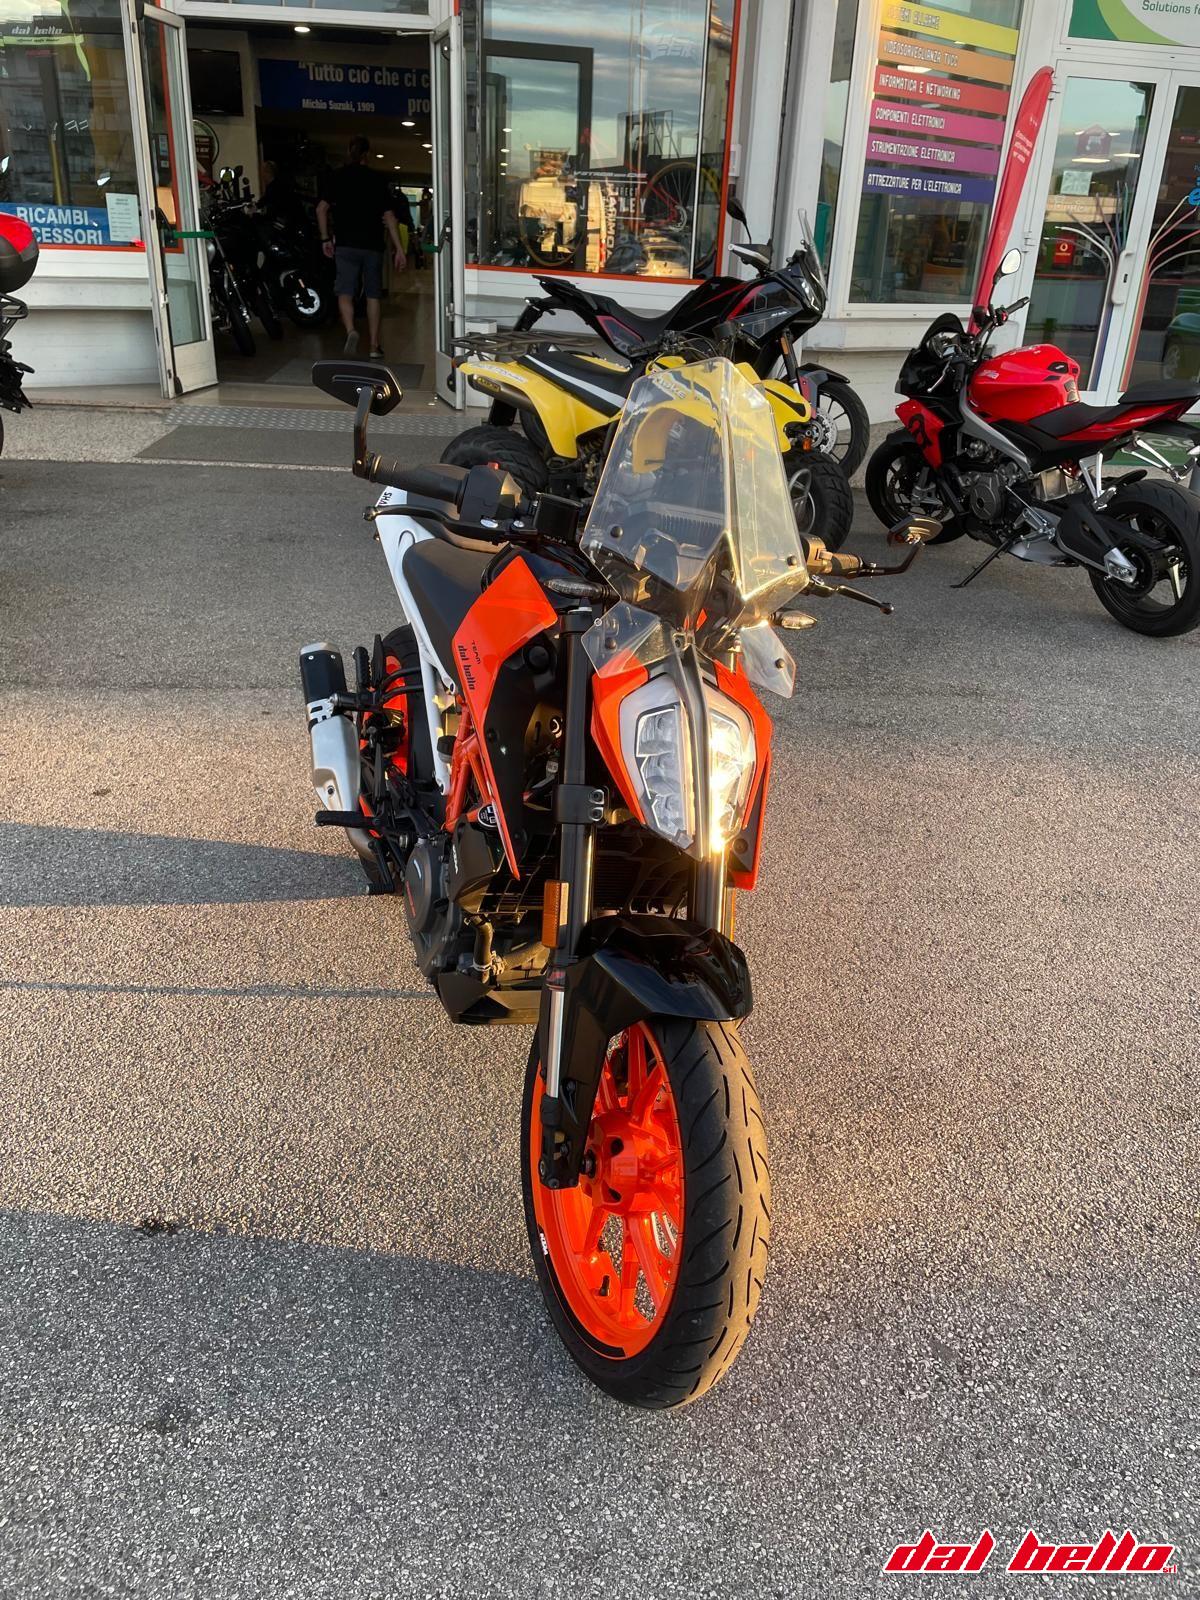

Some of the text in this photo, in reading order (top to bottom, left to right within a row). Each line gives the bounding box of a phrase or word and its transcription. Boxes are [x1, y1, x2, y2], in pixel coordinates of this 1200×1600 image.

[1142, 0, 1191, 14] Solutions
[348, 66, 370, 84] ciò
[374, 67, 400, 86] che
[404, 69, 417, 88] ci
[879, 73, 961, 101] INFORMATICA E NETWORKING
[302, 98, 327, 109] Michio
[328, 100, 355, 112] Suzuki,
[875, 107, 945, 129] COMPONENTI ELETTRONICI
[871, 140, 955, 163] STRUMENTAZIONE ELETTRONICA
[867, 173, 962, 194] ATTREZZATURE PER L'ELETTRONICA
[16, 206, 89, 226] RICAMBI
[31, 227, 103, 245] CESSORI
